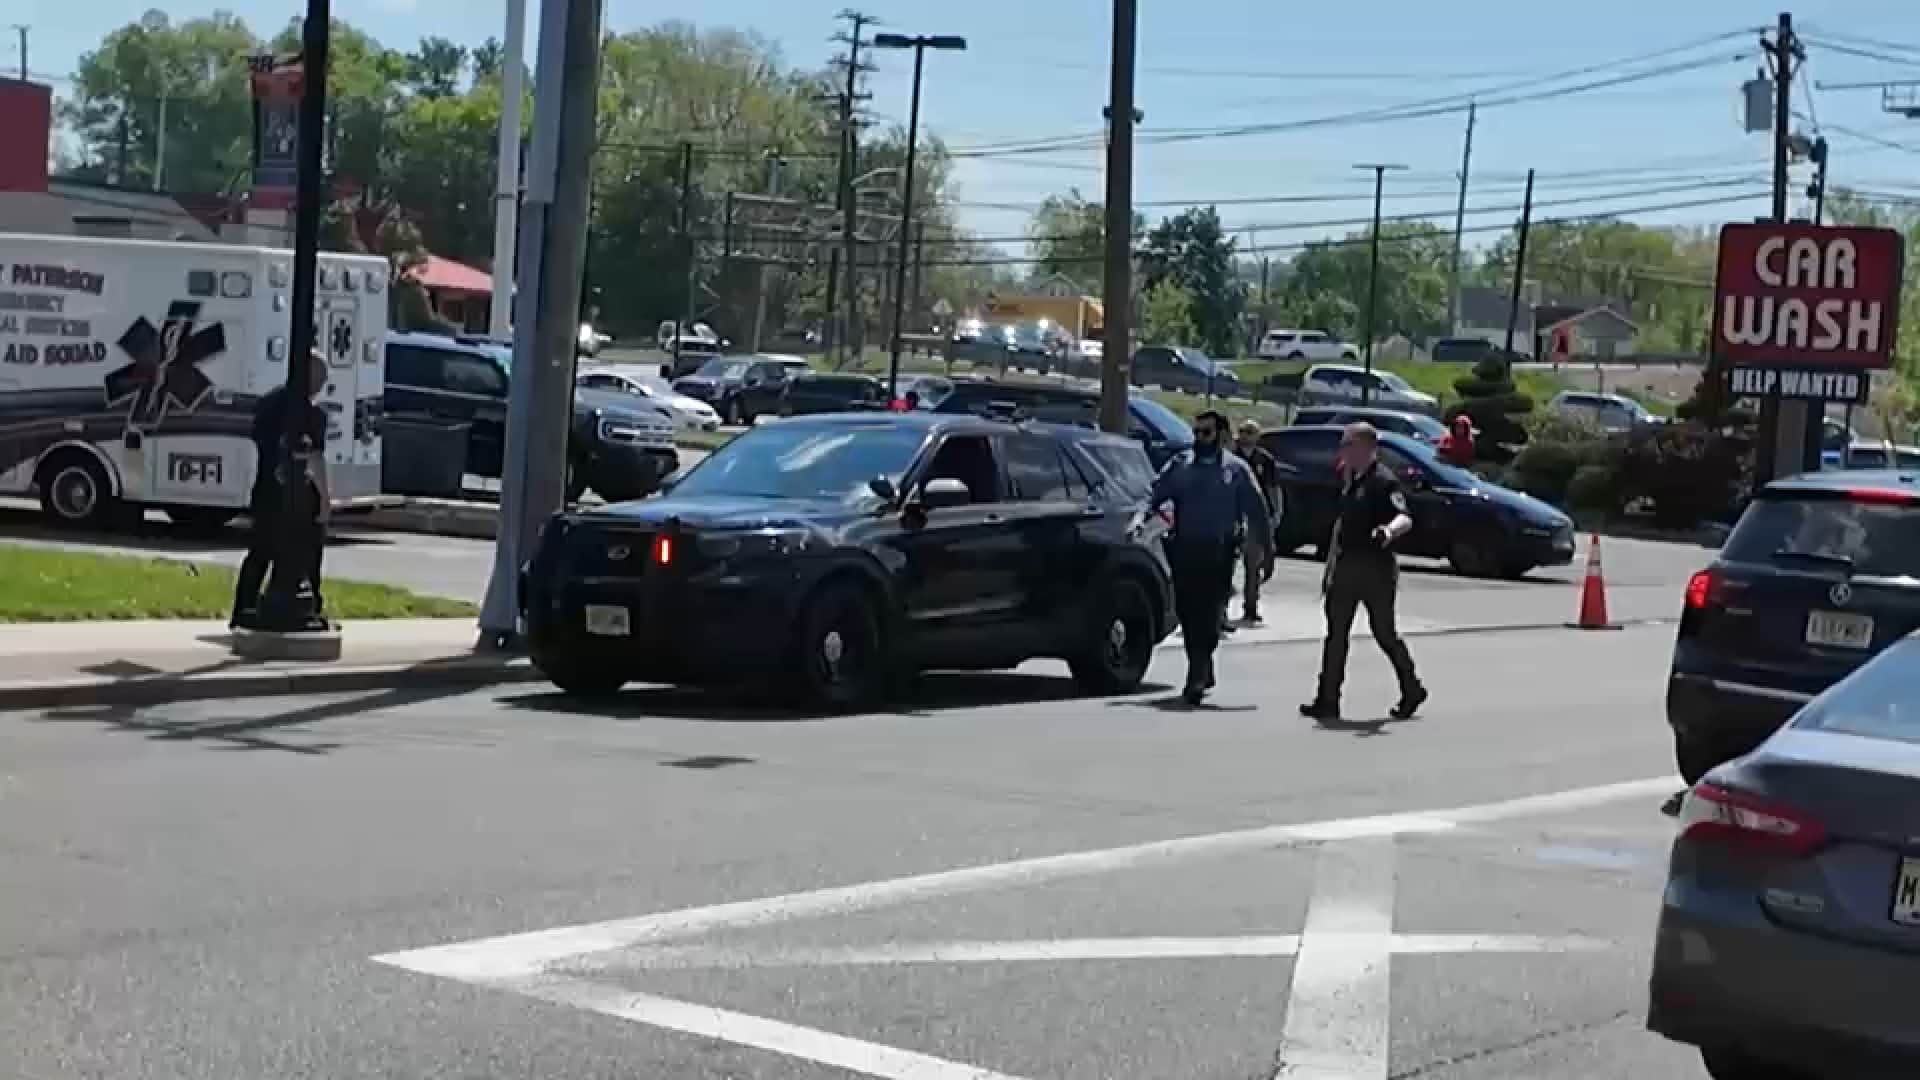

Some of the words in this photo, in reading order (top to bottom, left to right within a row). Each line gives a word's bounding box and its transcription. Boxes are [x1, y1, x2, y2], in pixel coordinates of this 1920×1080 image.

[1755, 236, 1857, 288] CAR
[1723, 295, 1881, 351] WASH
[4, 343, 38, 363] AID
[44, 342, 106, 366] SQUAD
[1731, 369, 1776, 392] HELP
[1780, 371, 1859, 398] WANTED
